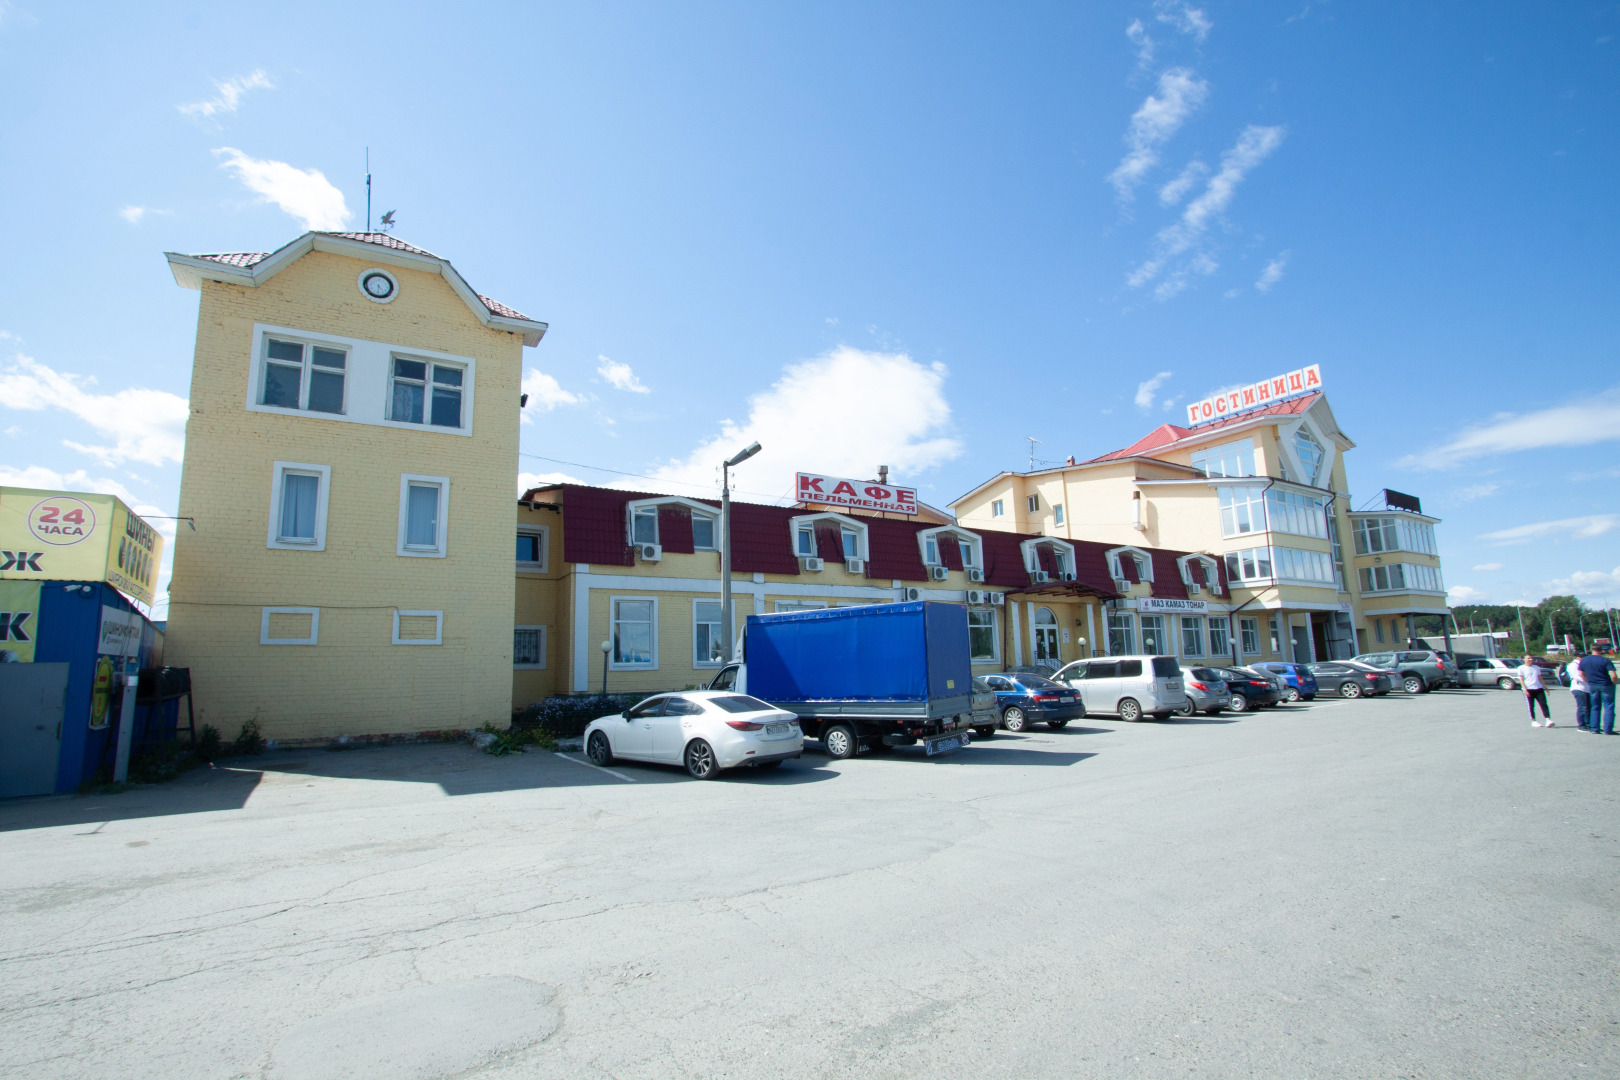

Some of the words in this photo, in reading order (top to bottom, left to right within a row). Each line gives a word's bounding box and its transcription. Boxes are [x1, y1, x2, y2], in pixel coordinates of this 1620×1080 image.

[1189, 368, 1319, 421] ГОСТИНИЦА
[799, 475, 916, 505] КАФЕ
[800, 491, 916, 513] ПЕЛЬМЕННАЯ
[39, 506, 86, 525] 24
[37, 524, 84, 536] ЧАСА
[126, 510, 156, 553] ШИНЫ
[1150, 599, 1164, 608] МАЗ
[1165, 600, 1185, 609] КАМАЗ
[1186, 601, 1205, 609] ТОНАР
